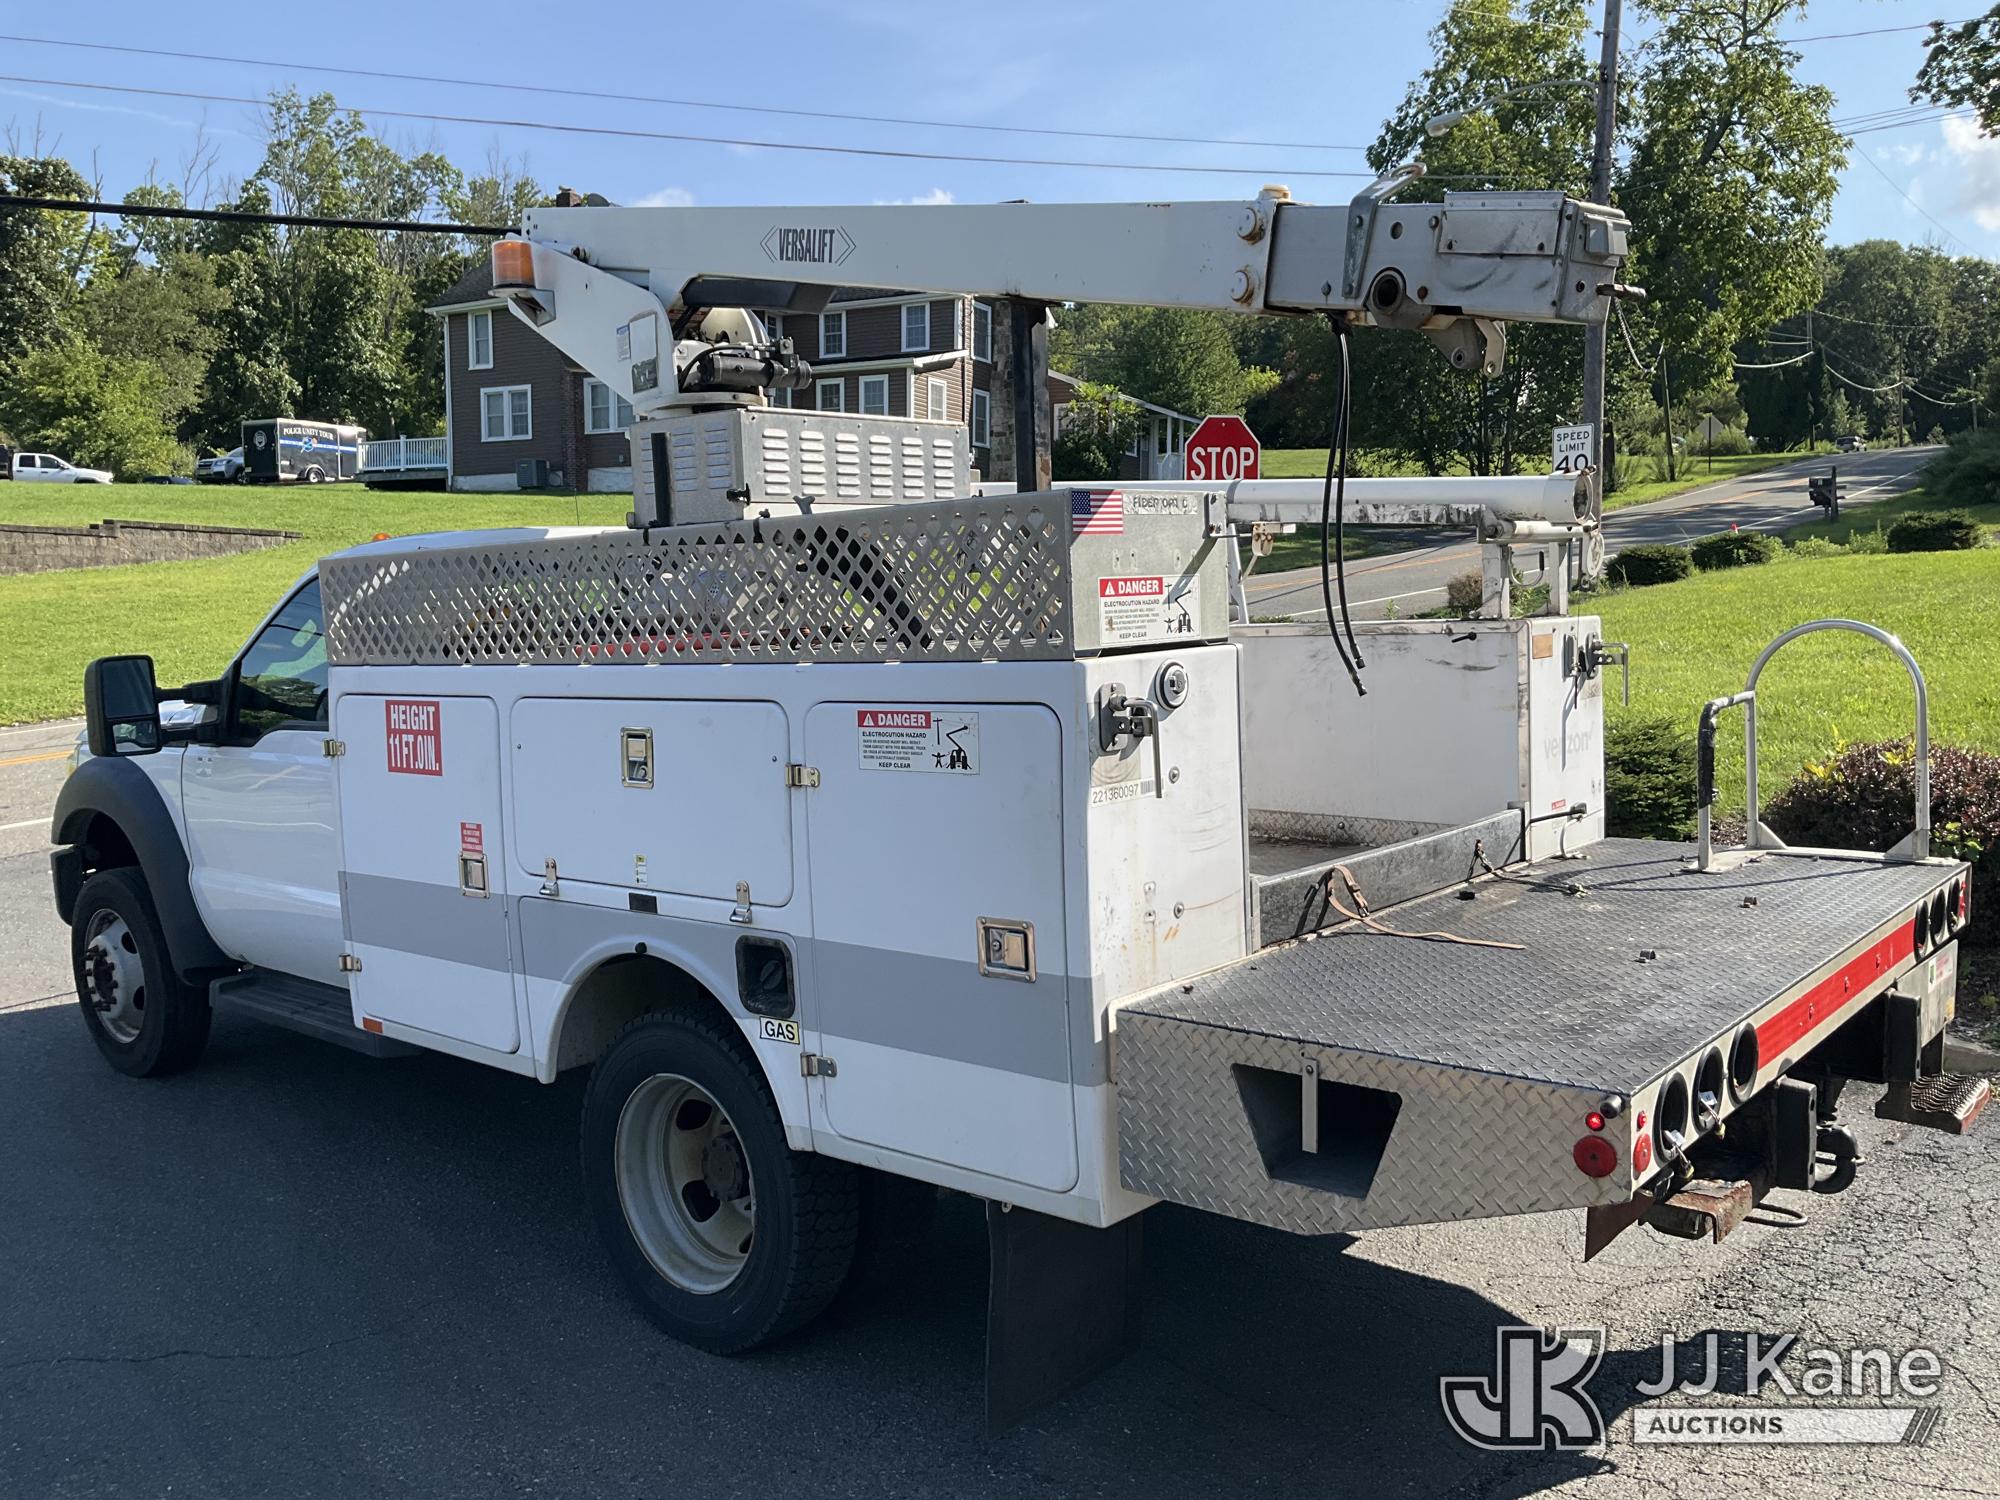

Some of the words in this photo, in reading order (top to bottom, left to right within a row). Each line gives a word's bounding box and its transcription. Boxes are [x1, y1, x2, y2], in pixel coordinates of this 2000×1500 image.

[779, 228, 835, 263] VERSALIFT
[283, 427, 302, 436] POLICE
[302, 427, 319, 436] UNITY
[319, 429, 334, 440] TOUR
[1556, 431, 1590, 442] SPEED
[1559, 442, 1586, 453] LIMIT
[1190, 446, 1255, 480] STOP
[1555, 453, 1589, 471] 40
[1118, 580, 1160, 594] DANGER
[1104, 600, 1142, 608] ELECTROCUTION
[1132, 631, 1147, 639] CLEAR
[390, 705, 435, 731] HEIGHT
[877, 713, 927, 727] DANGER
[1543, 732, 1589, 759] vezon
[1092, 784, 1139, 804] 221360097
[765, 1021, 795, 1041] GAS
